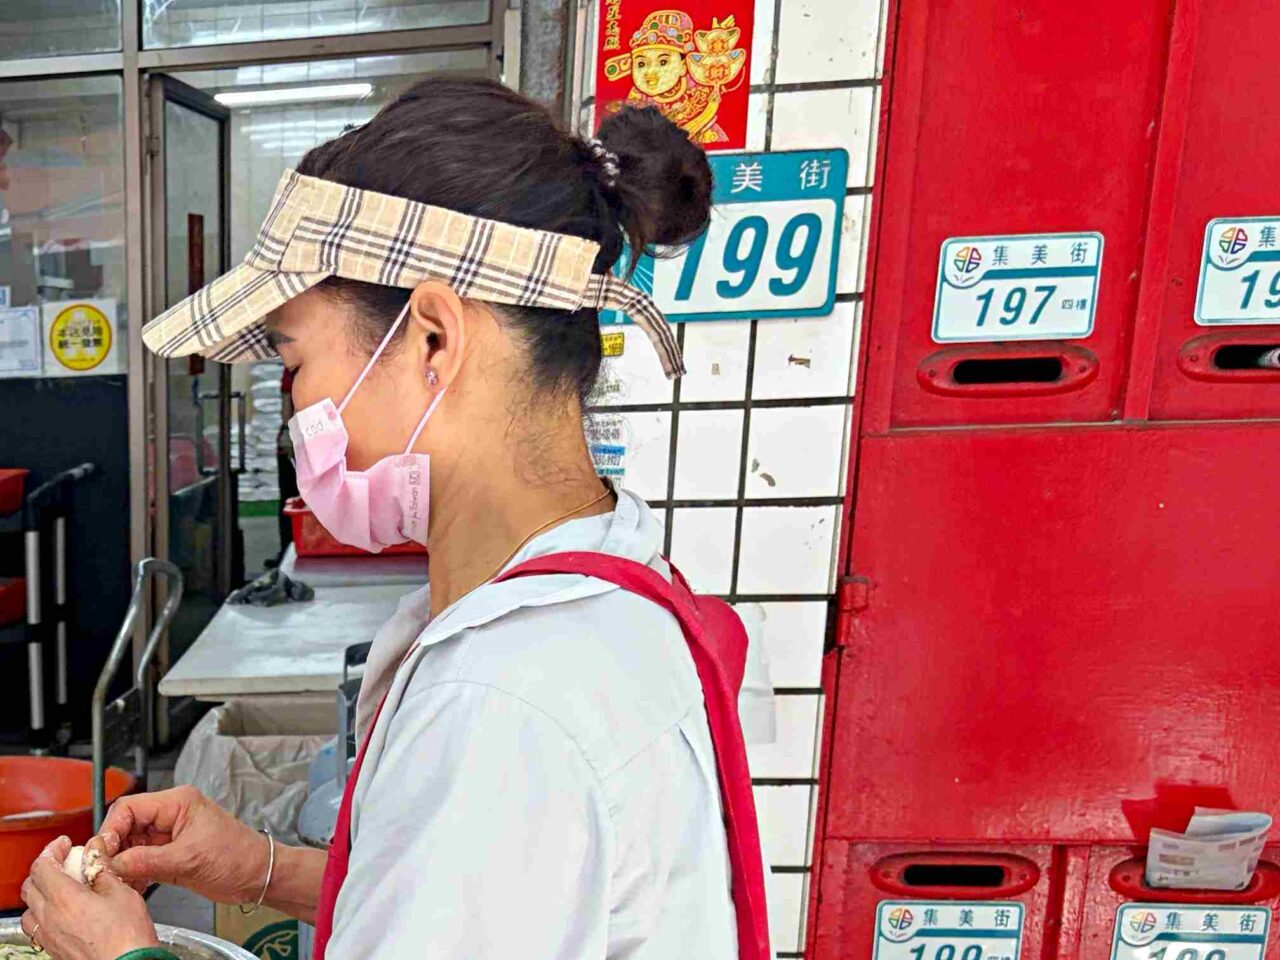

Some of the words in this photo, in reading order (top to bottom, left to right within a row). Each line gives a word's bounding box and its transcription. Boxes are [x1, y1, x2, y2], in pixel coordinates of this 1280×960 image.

[731, 159, 832, 193] 美街
[674, 212, 823, 301] 199
[991, 242, 1089, 267] 集美街
[975, 285, 1057, 327] 197
[922, 907, 1012, 929] 集美街
[1164, 911, 1258, 933] 集美街
